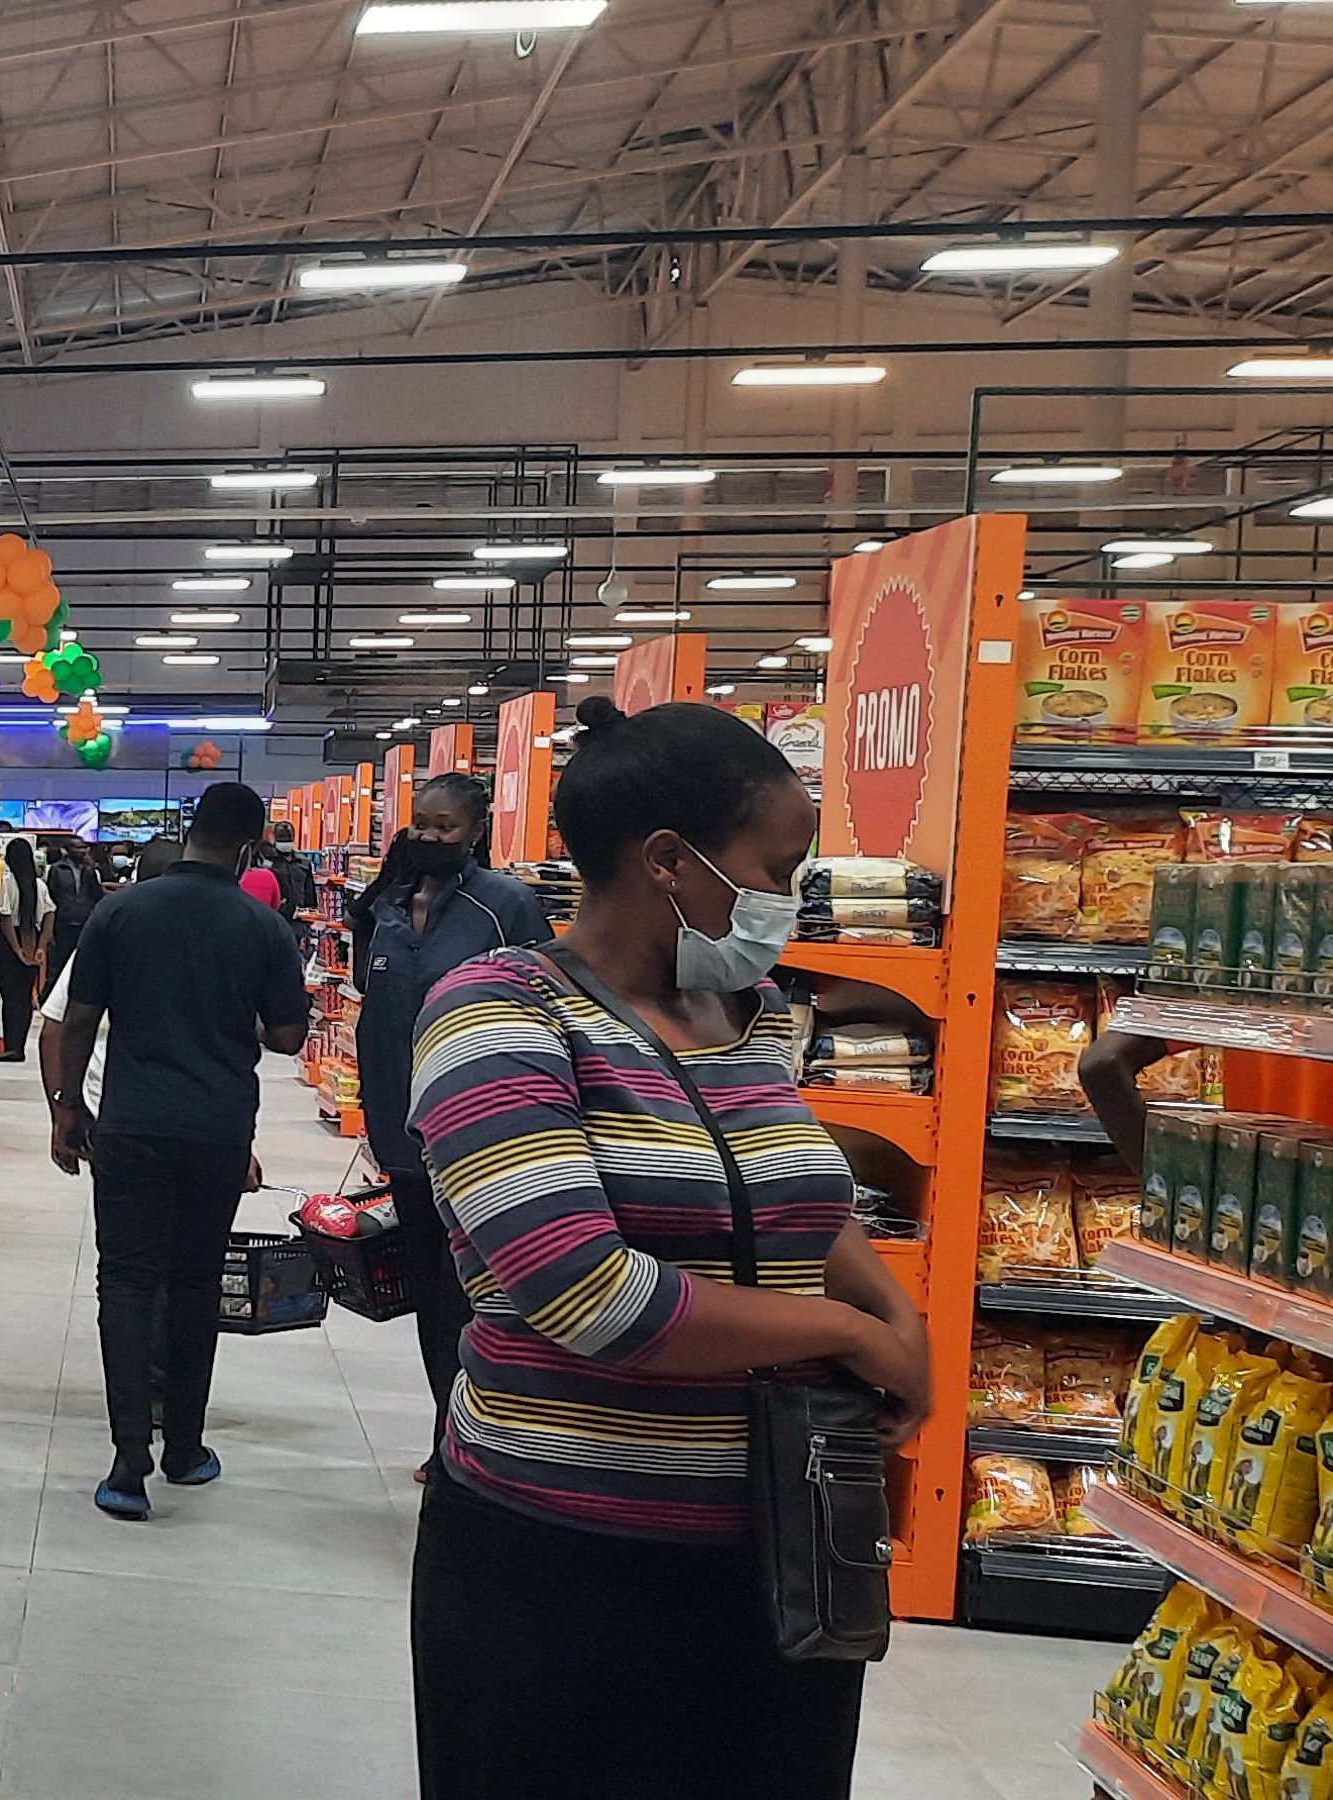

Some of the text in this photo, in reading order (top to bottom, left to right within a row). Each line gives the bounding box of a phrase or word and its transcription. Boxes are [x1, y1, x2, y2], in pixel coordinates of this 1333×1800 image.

[1058, 648, 1100, 664] Corn
[1186, 650, 1229, 666] Corn
[1048, 665, 1108, 681] Flakes
[1175, 667, 1237, 683] Flakes
[854, 682, 922, 773] PROMO
